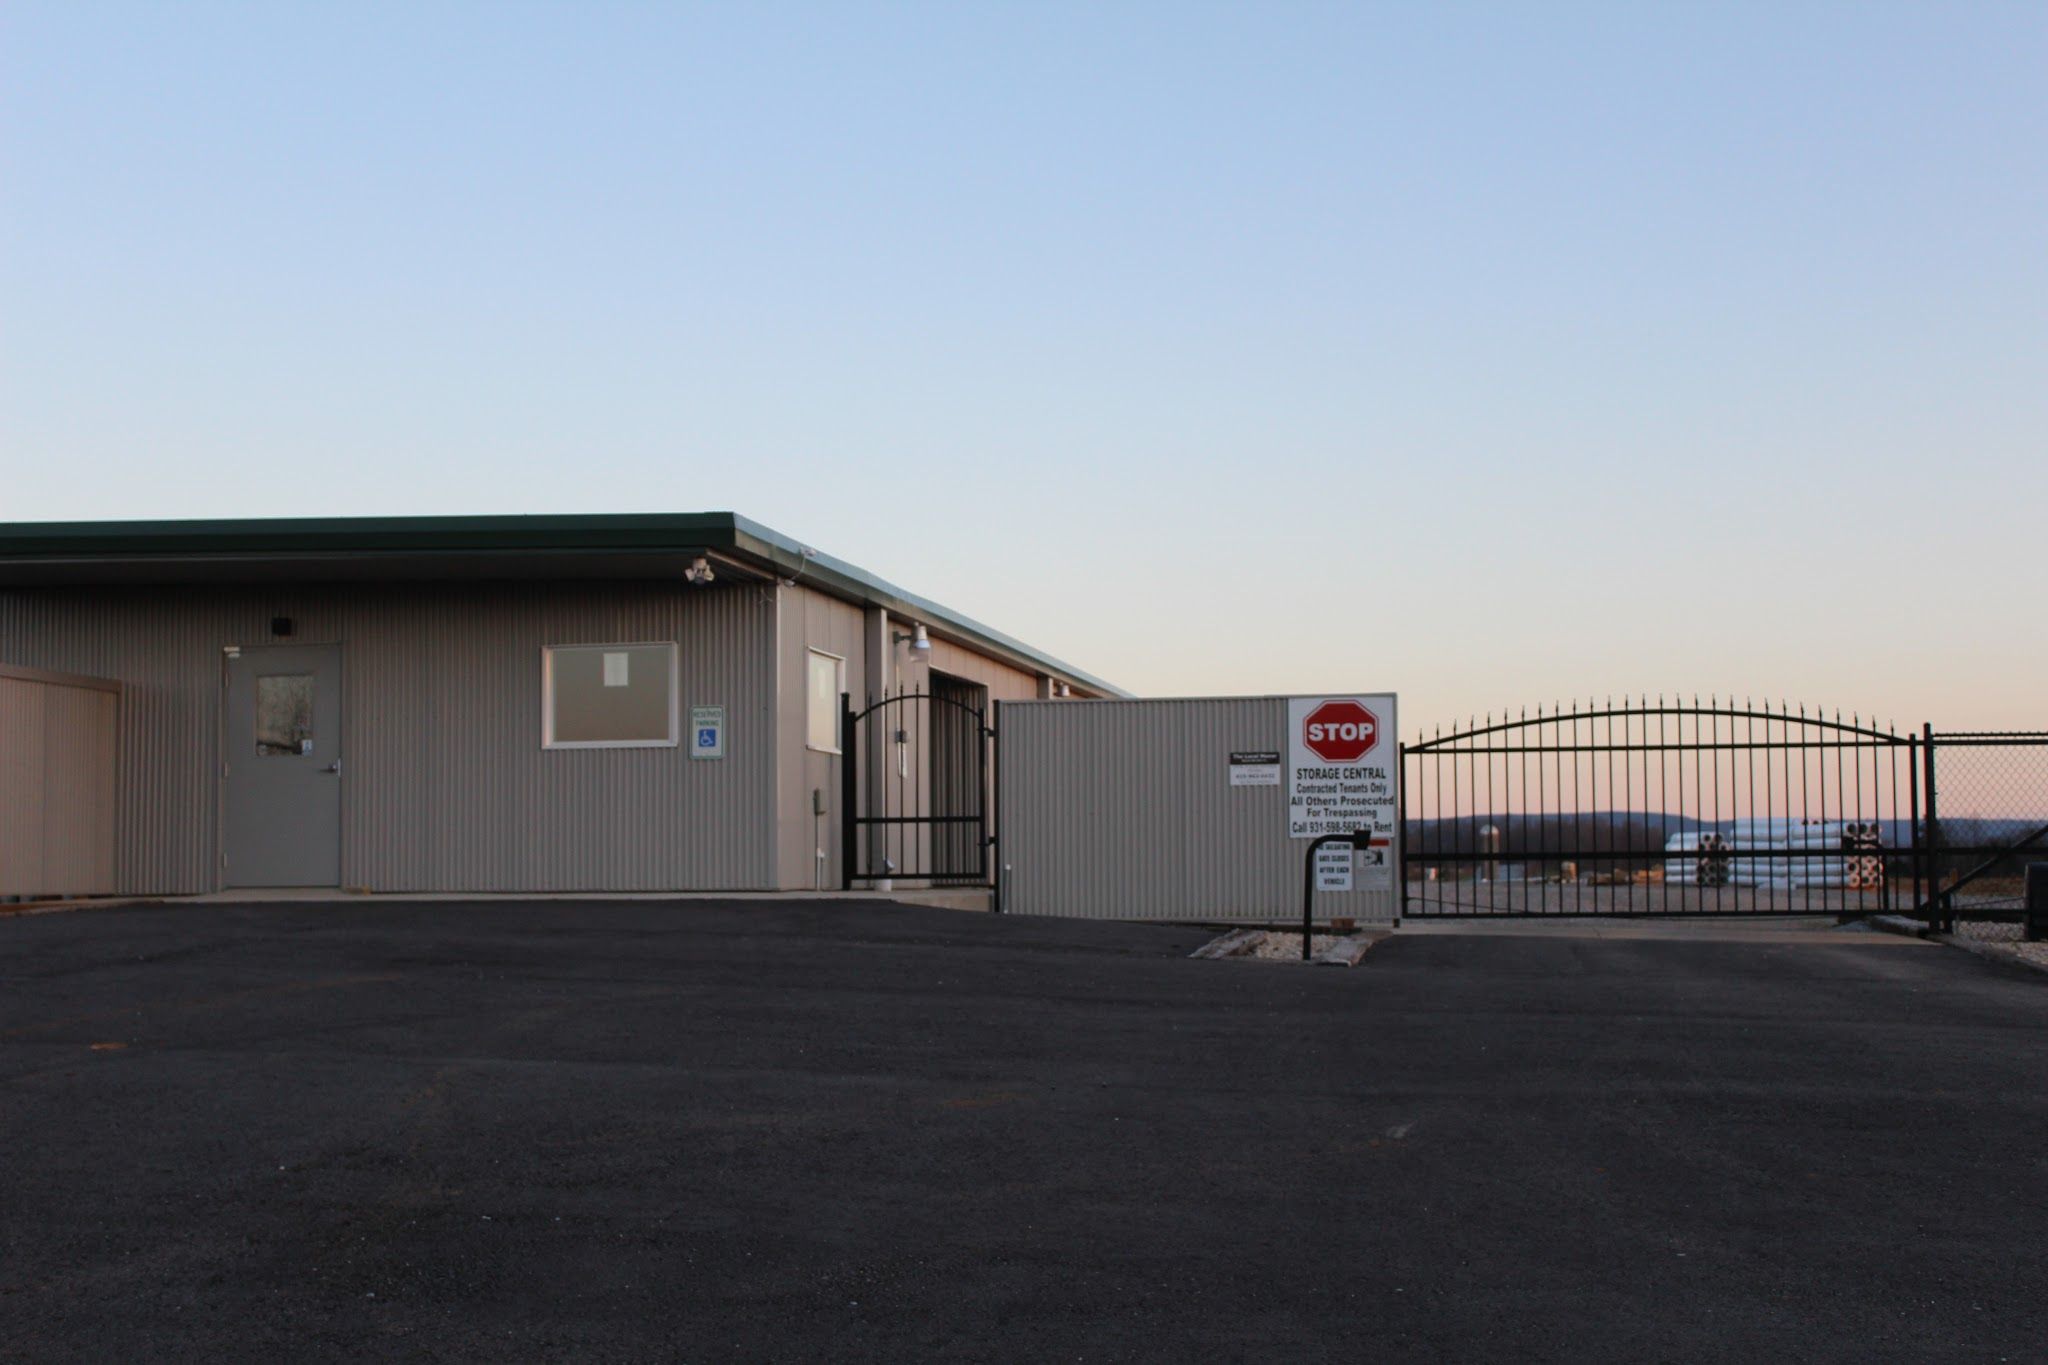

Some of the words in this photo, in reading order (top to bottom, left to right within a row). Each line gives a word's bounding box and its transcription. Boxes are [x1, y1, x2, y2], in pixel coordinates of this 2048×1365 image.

[1308, 723, 1374, 742] STOP
[1297, 768, 1340, 780] STORAGE
[1343, 767, 1386, 780] CENTRAL
[1297, 783, 1337, 794] Contracted
[1339, 783, 1368, 794] Tenants
[1370, 783, 1387, 795] Only
[1291, 796, 1303, 806] All
[1306, 796, 1338, 806] Others
[1340, 796, 1394, 806] Prosecuted
[1307, 808, 1321, 817] For
[1324, 808, 1378, 819] Trespassing
[1292, 822, 1307, 833] Call
[1309, 821, 1362, 833] 931-598-5682
[1363, 822, 1372, 831] to
[1374, 822, 1393, 832] Rent
